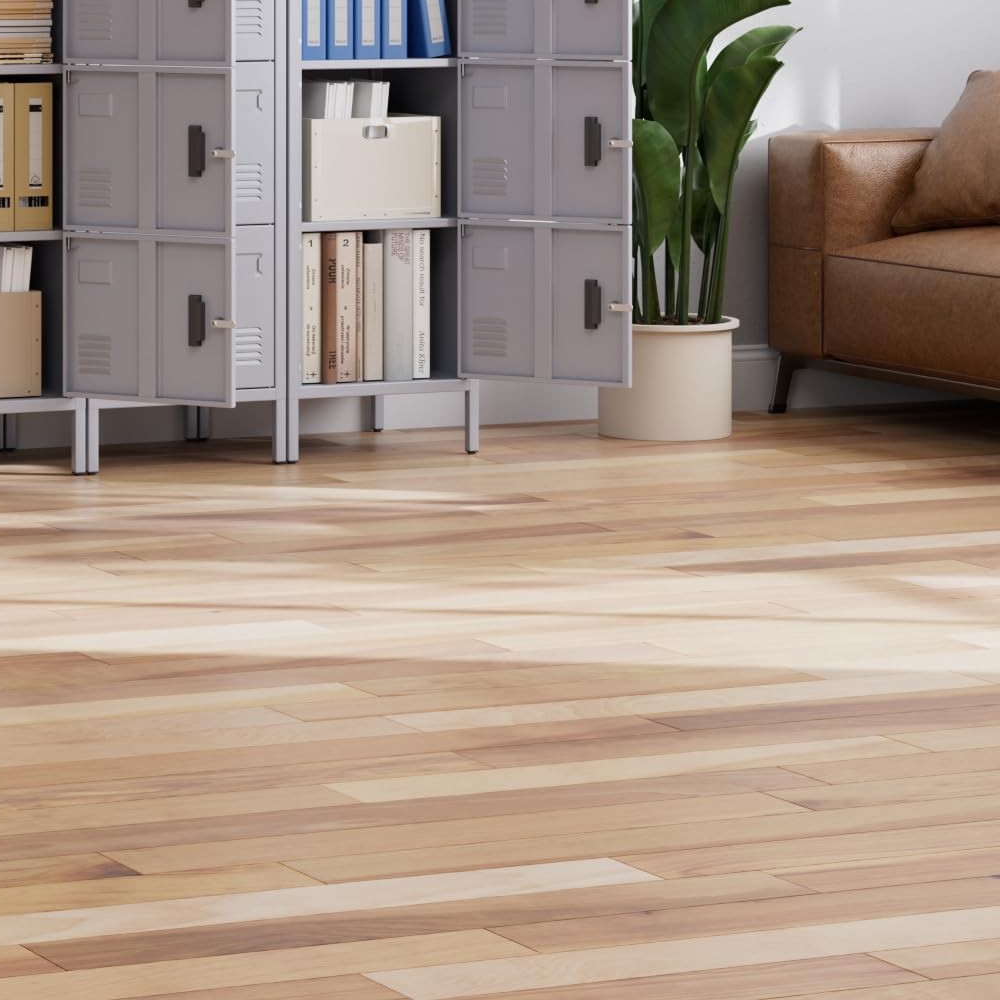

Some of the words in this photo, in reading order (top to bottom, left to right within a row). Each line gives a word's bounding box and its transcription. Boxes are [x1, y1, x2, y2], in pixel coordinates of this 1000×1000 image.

[307, 239, 313, 248] 1
[342, 238, 350, 247] 2
[419, 233, 425, 245] No
